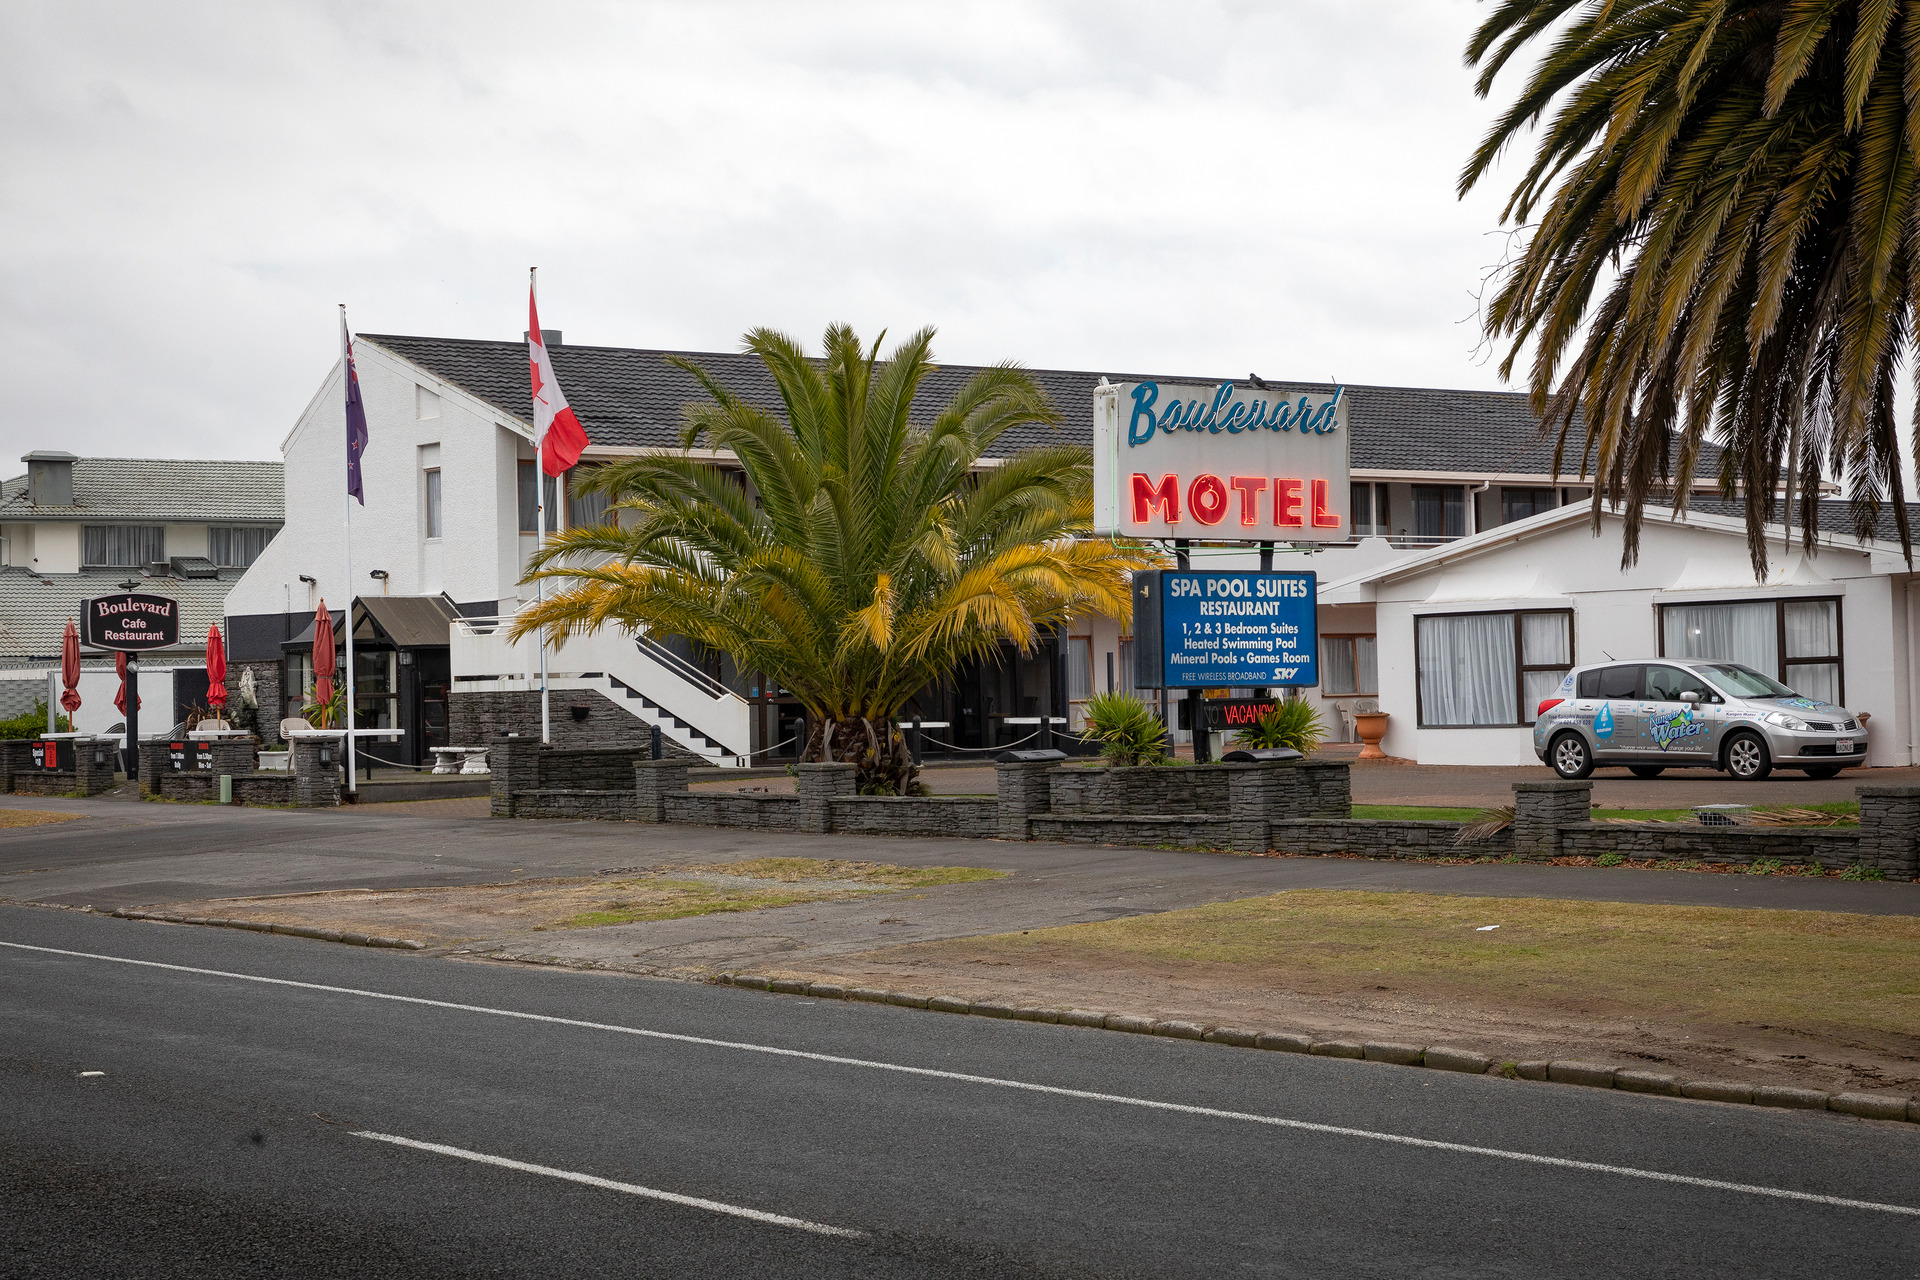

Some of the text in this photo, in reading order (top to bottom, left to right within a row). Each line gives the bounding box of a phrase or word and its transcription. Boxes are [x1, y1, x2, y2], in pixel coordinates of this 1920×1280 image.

[1128, 380, 1345, 448] Boulevard
[1130, 473, 1342, 529] MOTEL
[1170, 578, 1308, 598] SPA POOL SUITES
[97, 597, 171, 618] Boulevard
[1199, 600, 1280, 616] RESTAURANT
[121, 618, 147, 629] Cafe
[1194, 622, 1202, 635] 2
[1203, 622, 1213, 635] &
[1214, 622, 1222, 635] 3
[1224, 621, 1268, 635] Bedroom
[1270, 621, 1299, 635] Suites
[104, 629, 165, 641] Restaurant
[1184, 636, 1297, 652] Heated Swimming Pool
[1170, 651, 1310, 665] Mineral Pools Games Room
[1182, 671, 1267, 681] FREE WIRELESS BROADBAND
[1272, 667, 1299, 680] SKY
[1651, 722, 1704, 743] Water
